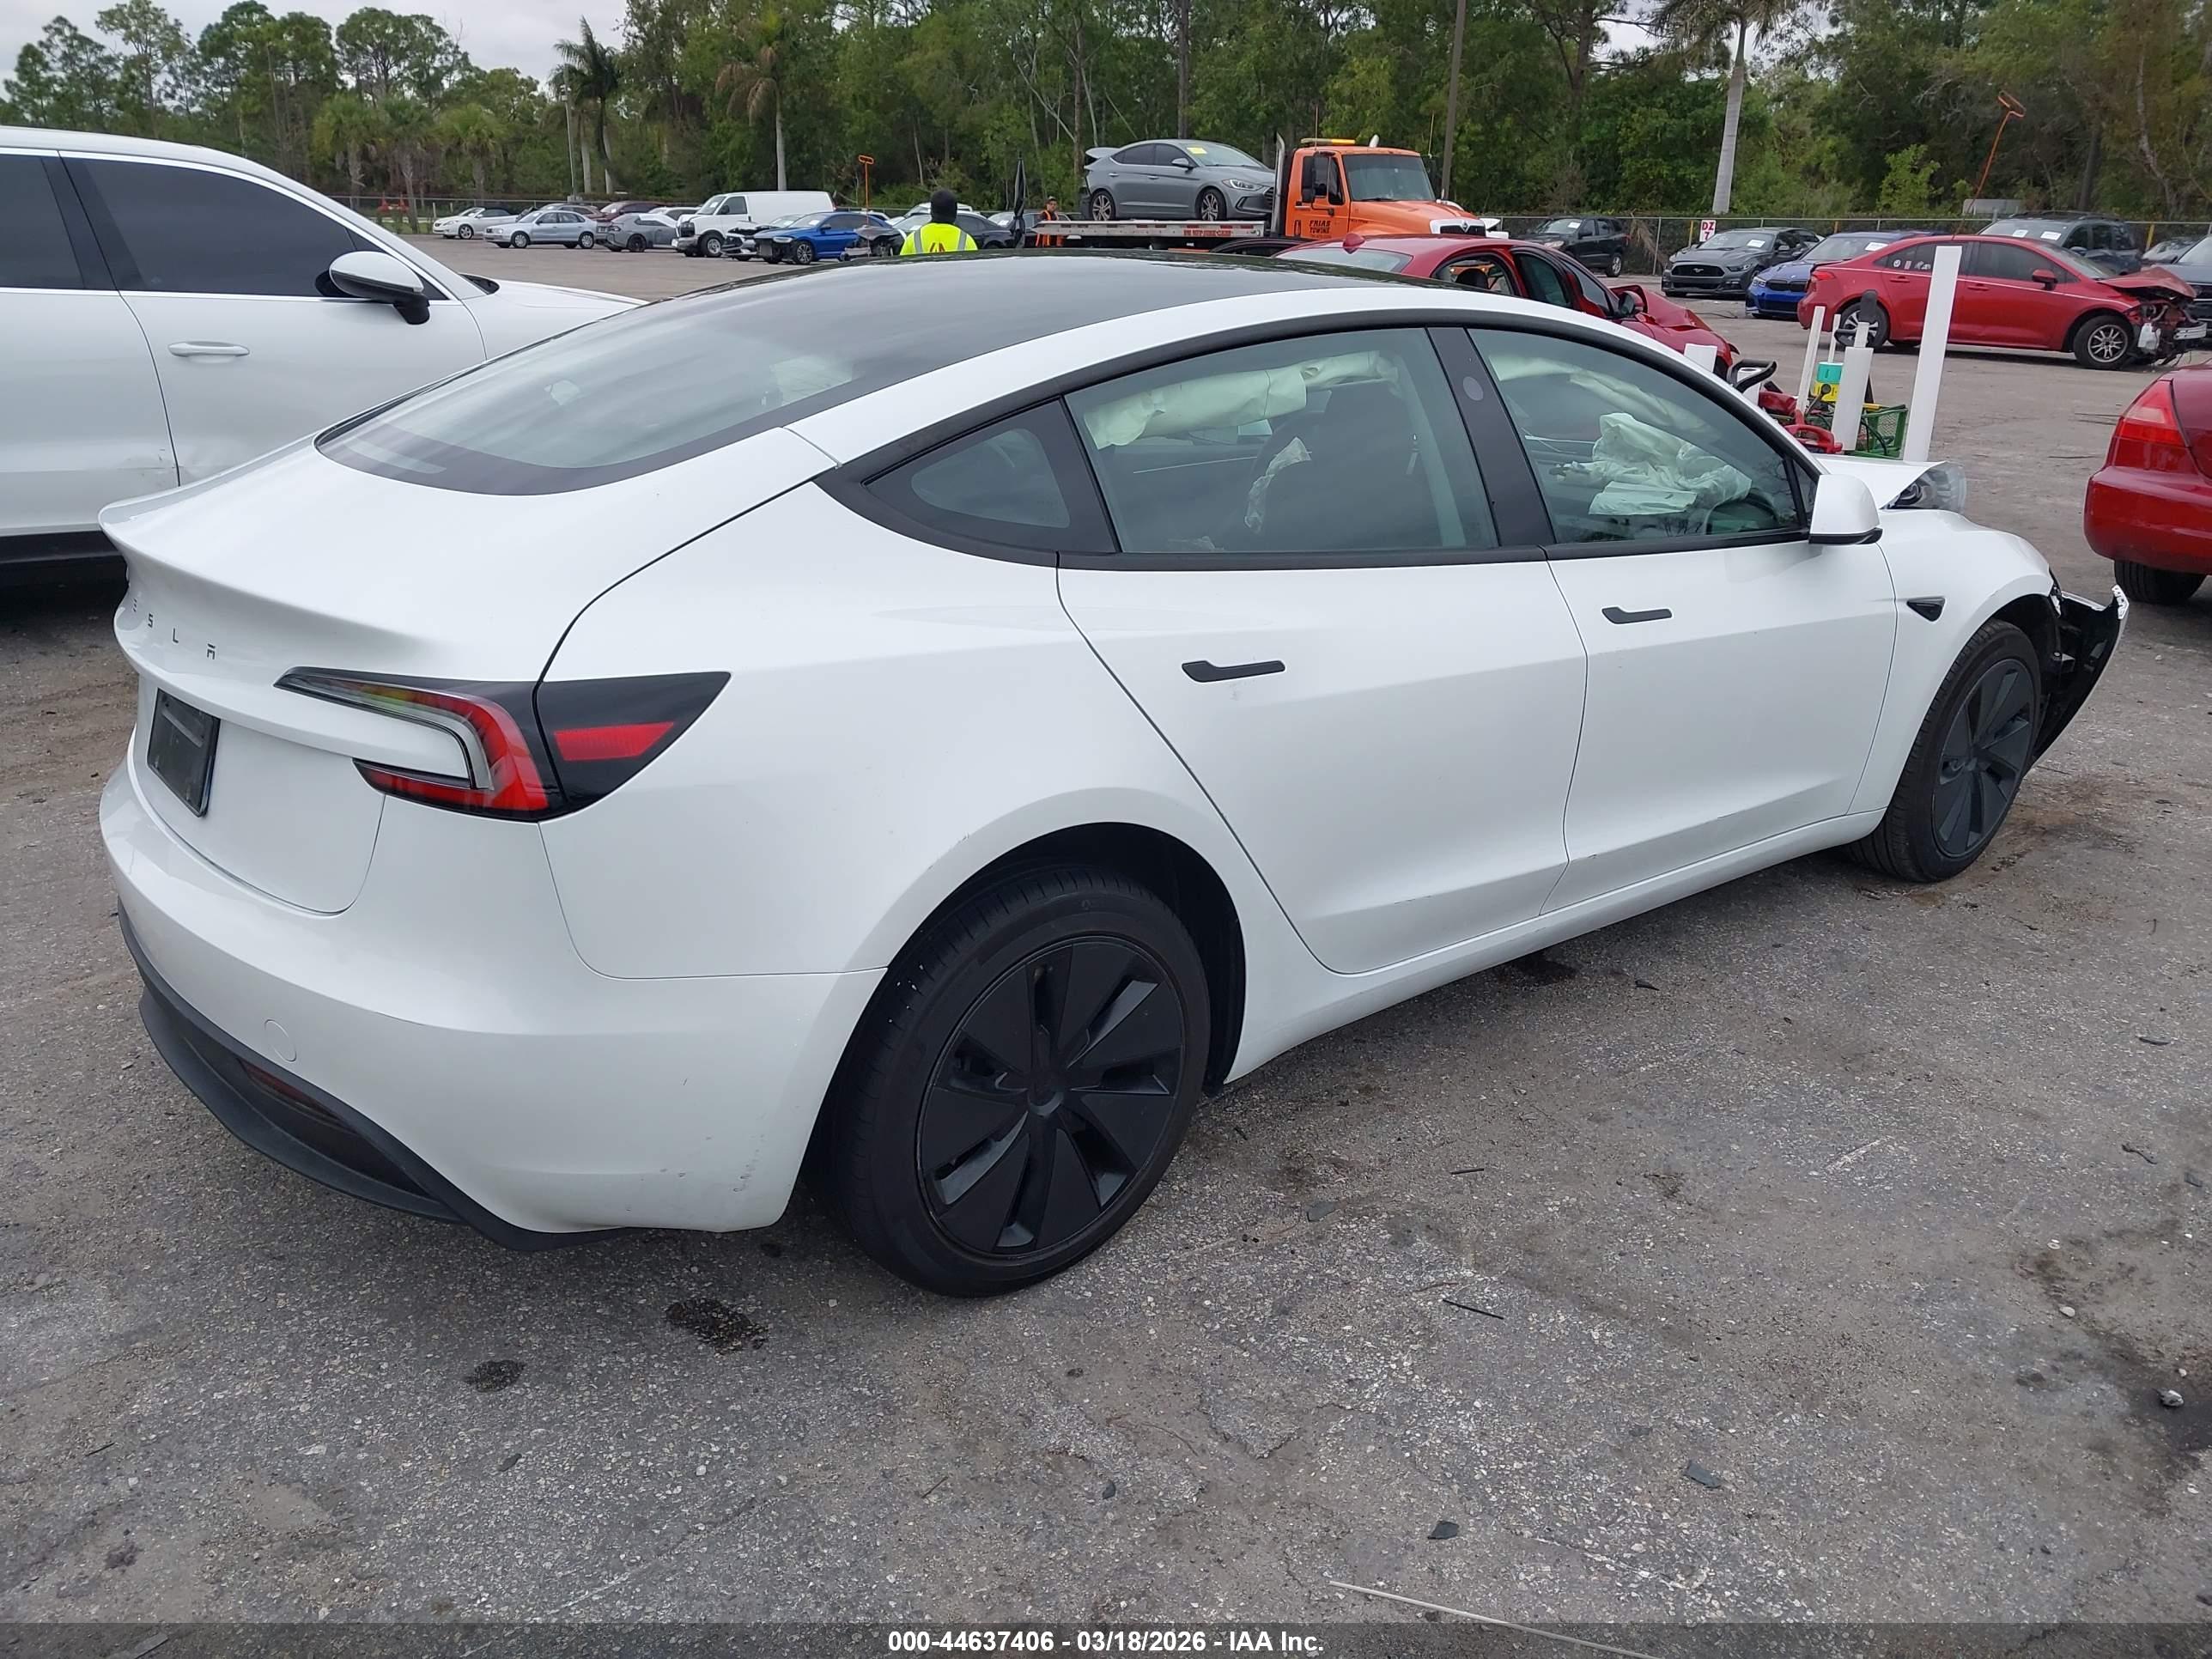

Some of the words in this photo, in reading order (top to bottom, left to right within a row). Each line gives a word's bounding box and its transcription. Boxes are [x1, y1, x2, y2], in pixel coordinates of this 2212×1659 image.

[1702, 222, 1714, 230] DZ
[1705, 231, 1710, 240] 7
[132, 598, 216, 660] ESLA
